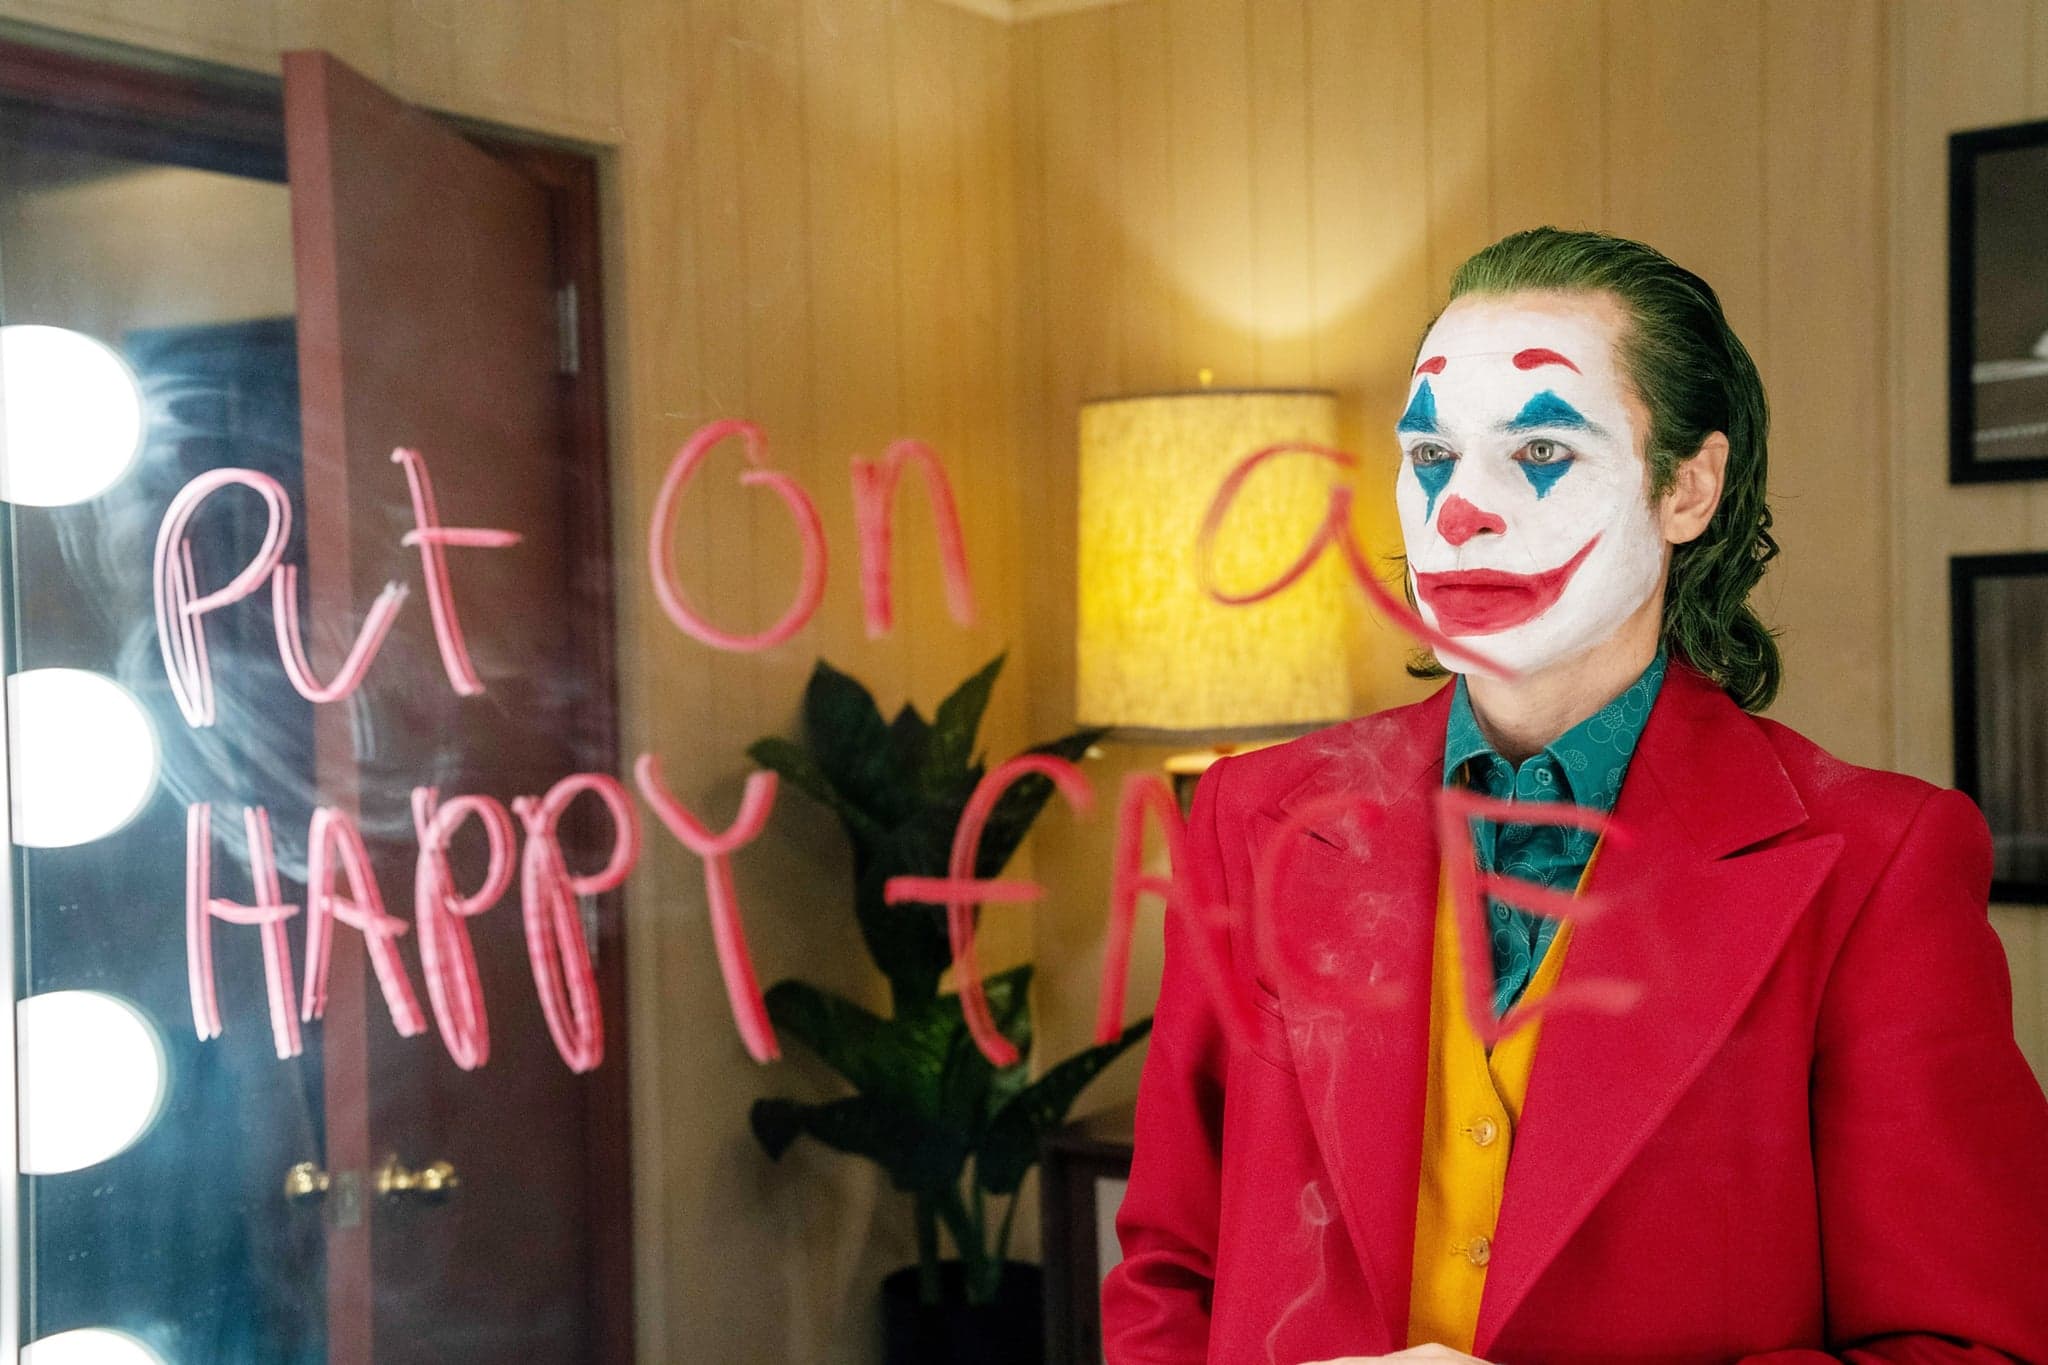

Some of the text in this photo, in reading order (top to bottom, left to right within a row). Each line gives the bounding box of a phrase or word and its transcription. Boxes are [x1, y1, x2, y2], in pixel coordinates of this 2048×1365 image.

[1196, 442, 1519, 679] a
[186, 753, 1645, 1073] HAPPY FACE
